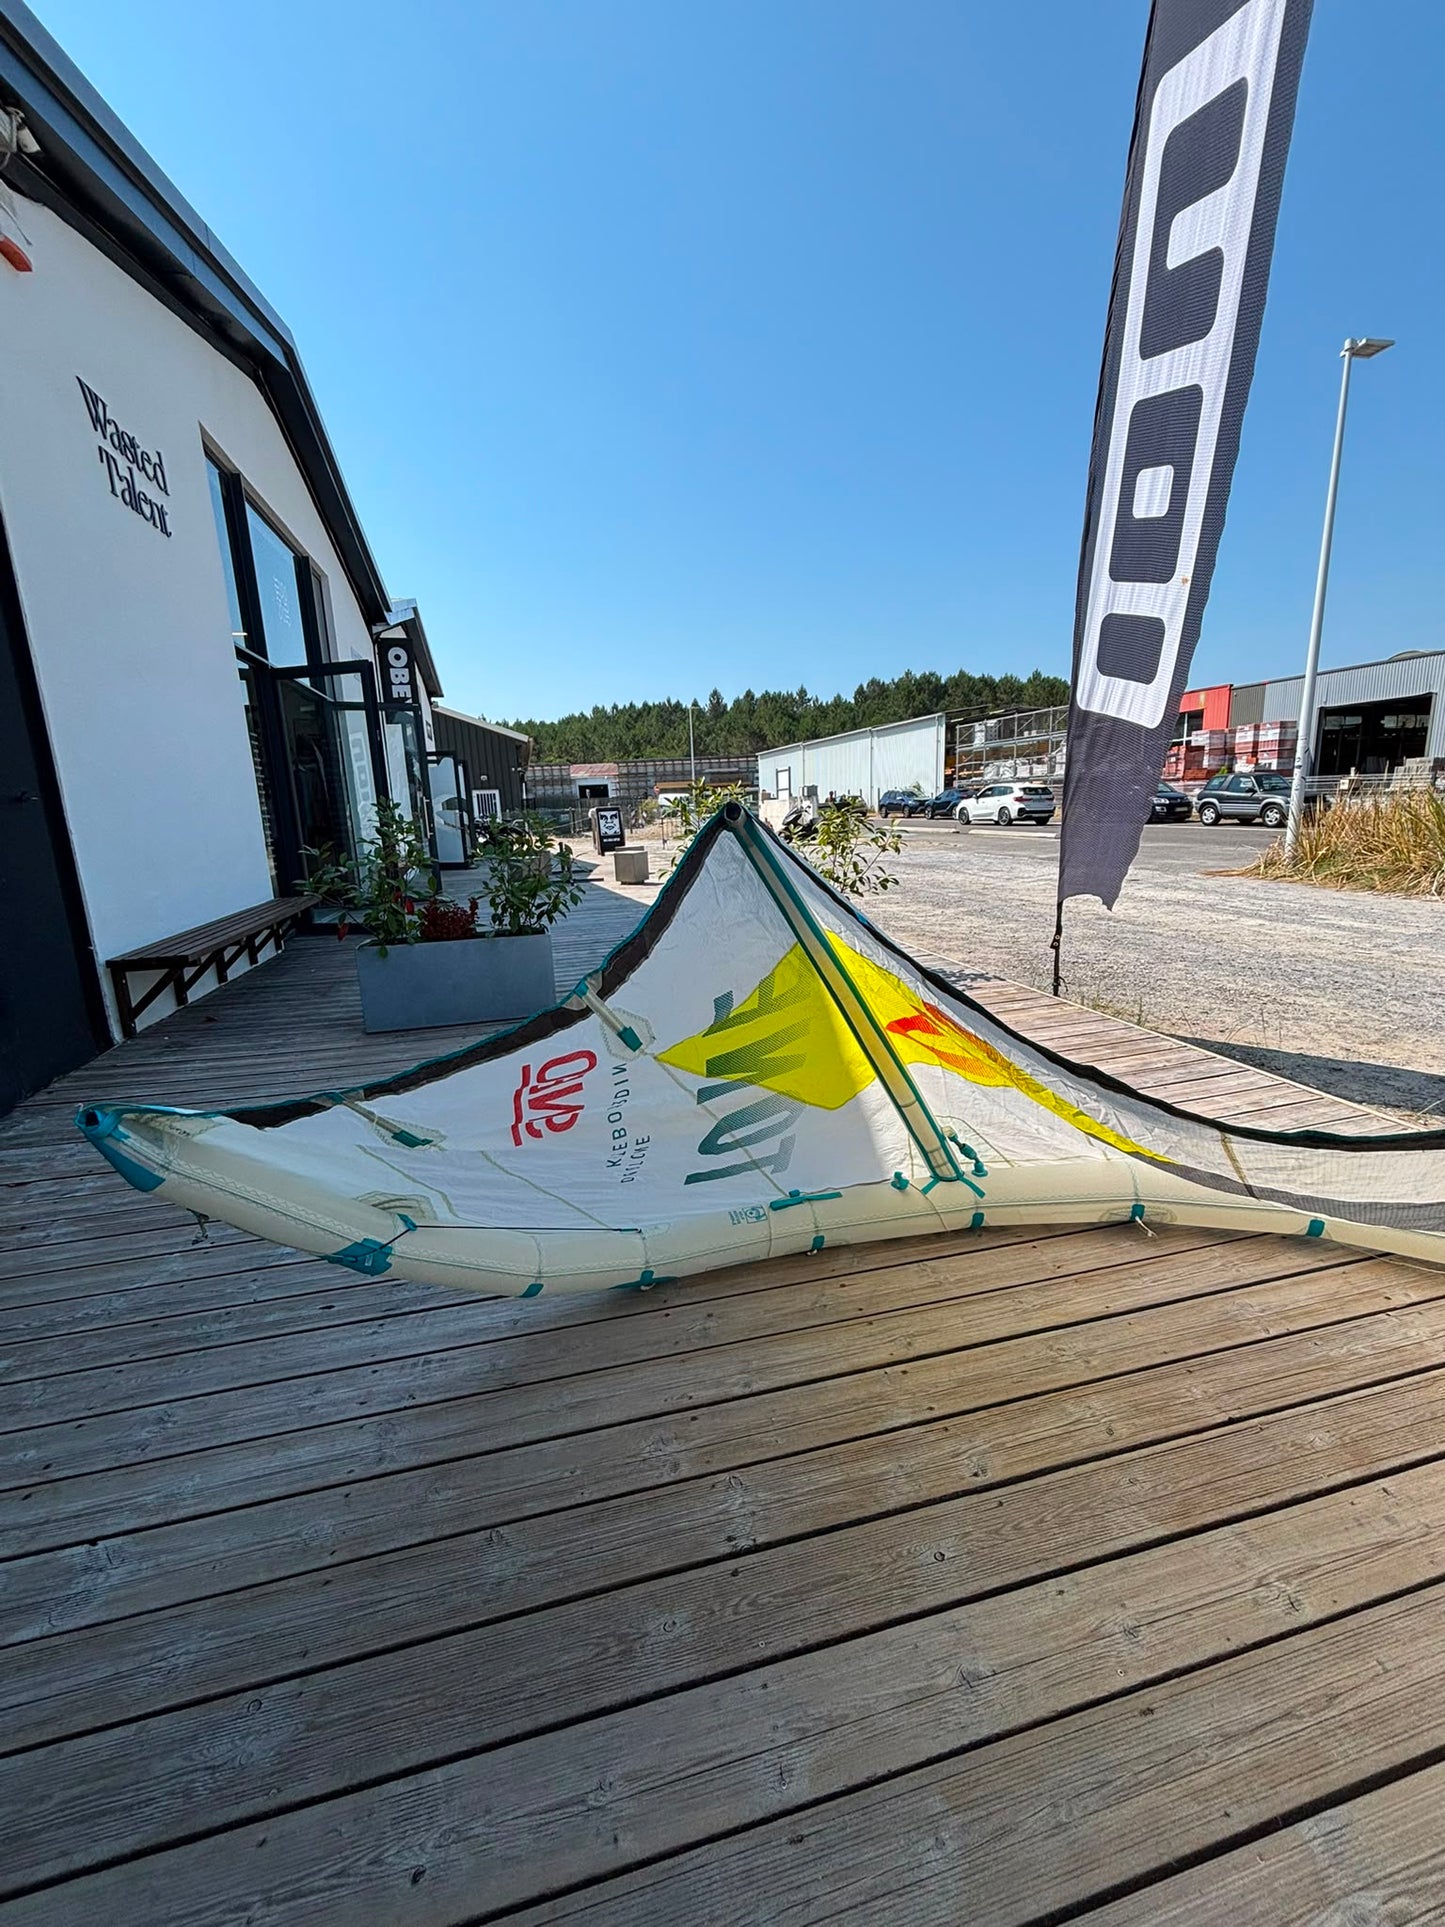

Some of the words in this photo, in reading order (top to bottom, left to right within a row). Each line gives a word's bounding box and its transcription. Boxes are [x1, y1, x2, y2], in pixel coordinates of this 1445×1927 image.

[76, 375, 170, 497] Wasted
[98, 445, 172, 538] Talent
[387, 646, 413, 704] OBE
